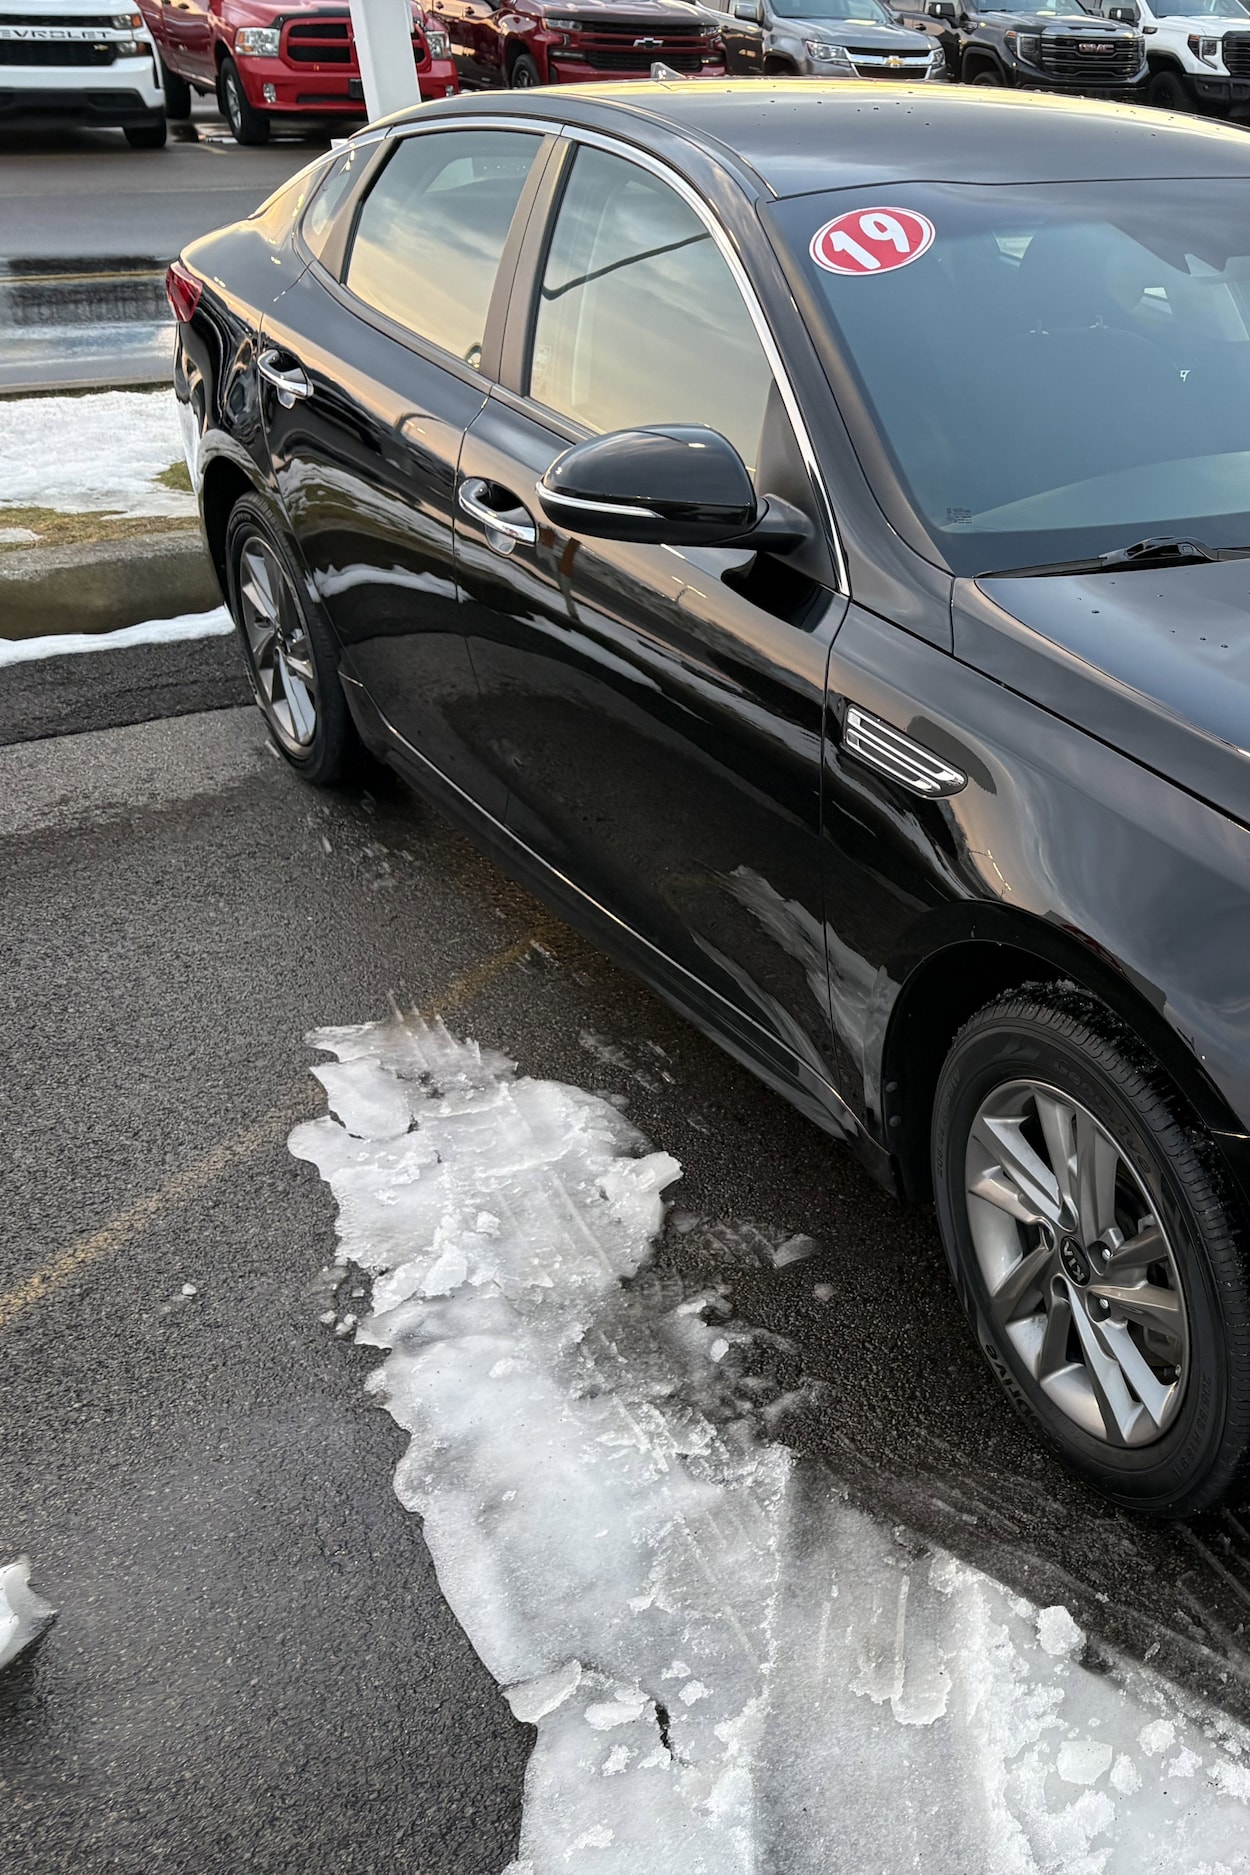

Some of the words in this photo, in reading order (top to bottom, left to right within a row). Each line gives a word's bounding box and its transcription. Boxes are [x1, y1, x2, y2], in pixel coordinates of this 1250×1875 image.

[1079, 43, 1114, 54] GMC
[829, 212, 911, 270] 19
[1063, 1241, 1086, 1282] KIA
